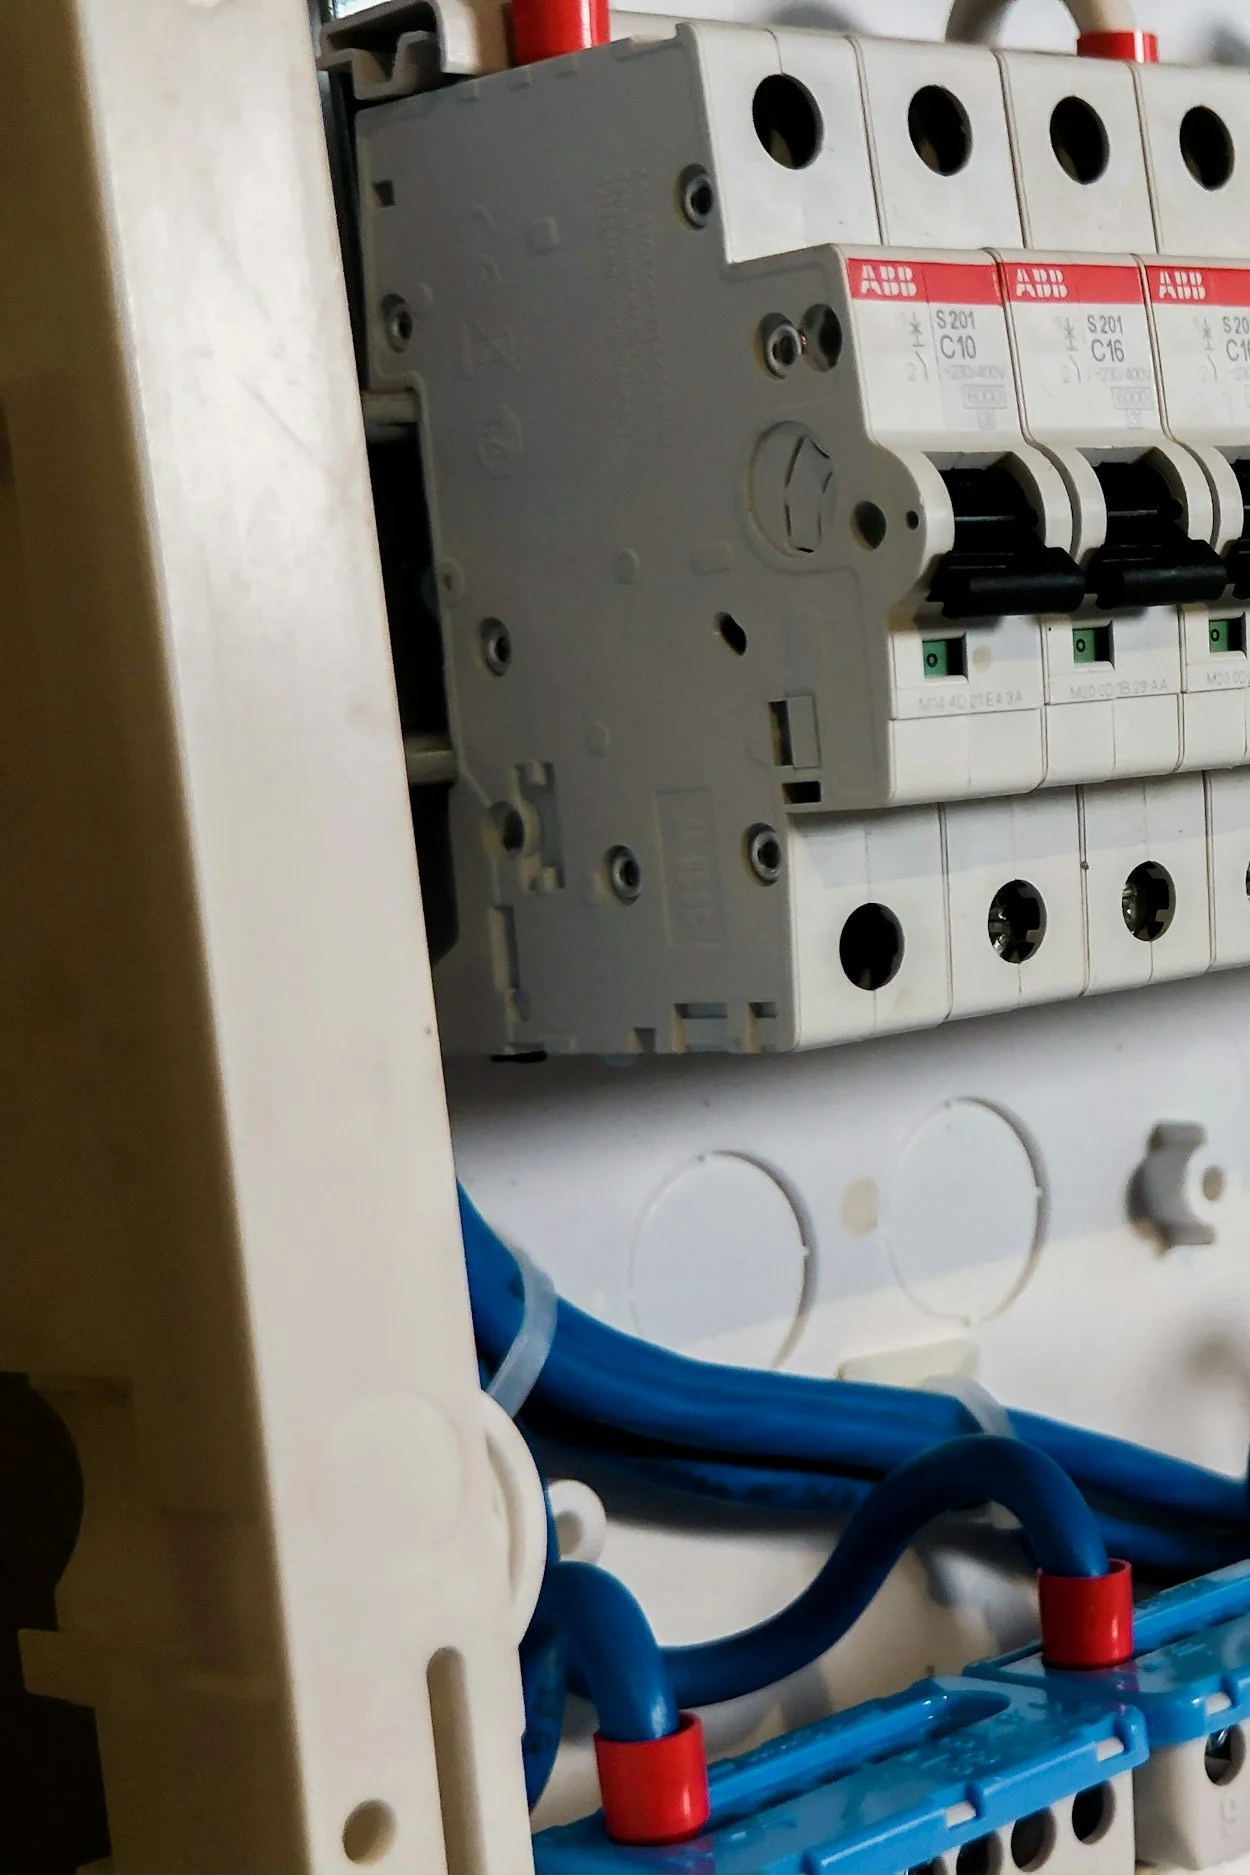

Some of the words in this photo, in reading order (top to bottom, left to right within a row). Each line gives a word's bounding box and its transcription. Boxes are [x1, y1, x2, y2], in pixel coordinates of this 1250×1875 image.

[860, 264, 918, 298] ABB
[1015, 267, 1068, 299] ABB
[1159, 271, 1207, 300] ABB
[940, 334, 977, 360] C10
[1091, 339, 1125, 363] C16
